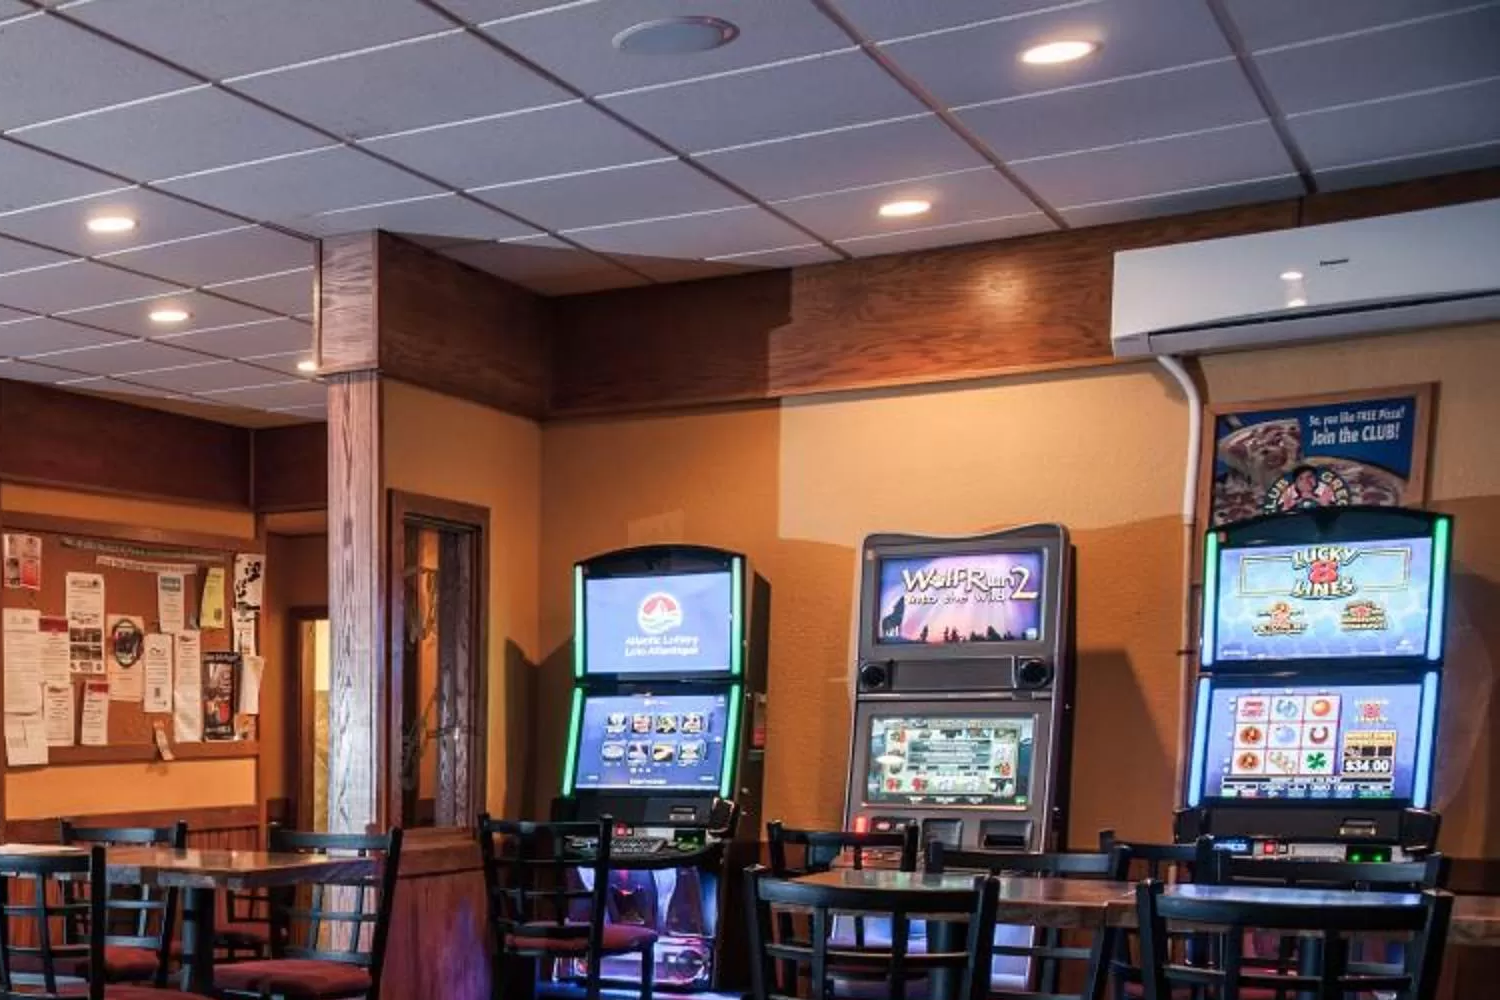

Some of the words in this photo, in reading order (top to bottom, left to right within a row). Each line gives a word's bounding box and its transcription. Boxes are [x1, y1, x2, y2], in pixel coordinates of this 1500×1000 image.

[1324, 415, 1338, 429] you
[1356, 410, 1376, 422] FREE
[1311, 428, 1336, 446] Join
[1339, 426, 1359, 443] the
[1362, 422, 1400, 441] CLUB!
[1292, 546, 1359, 569] LUCKY
[1011, 567, 1039, 600] 2
[1308, 560, 1339, 584] 8
[1291, 577, 1356, 599] LINES
